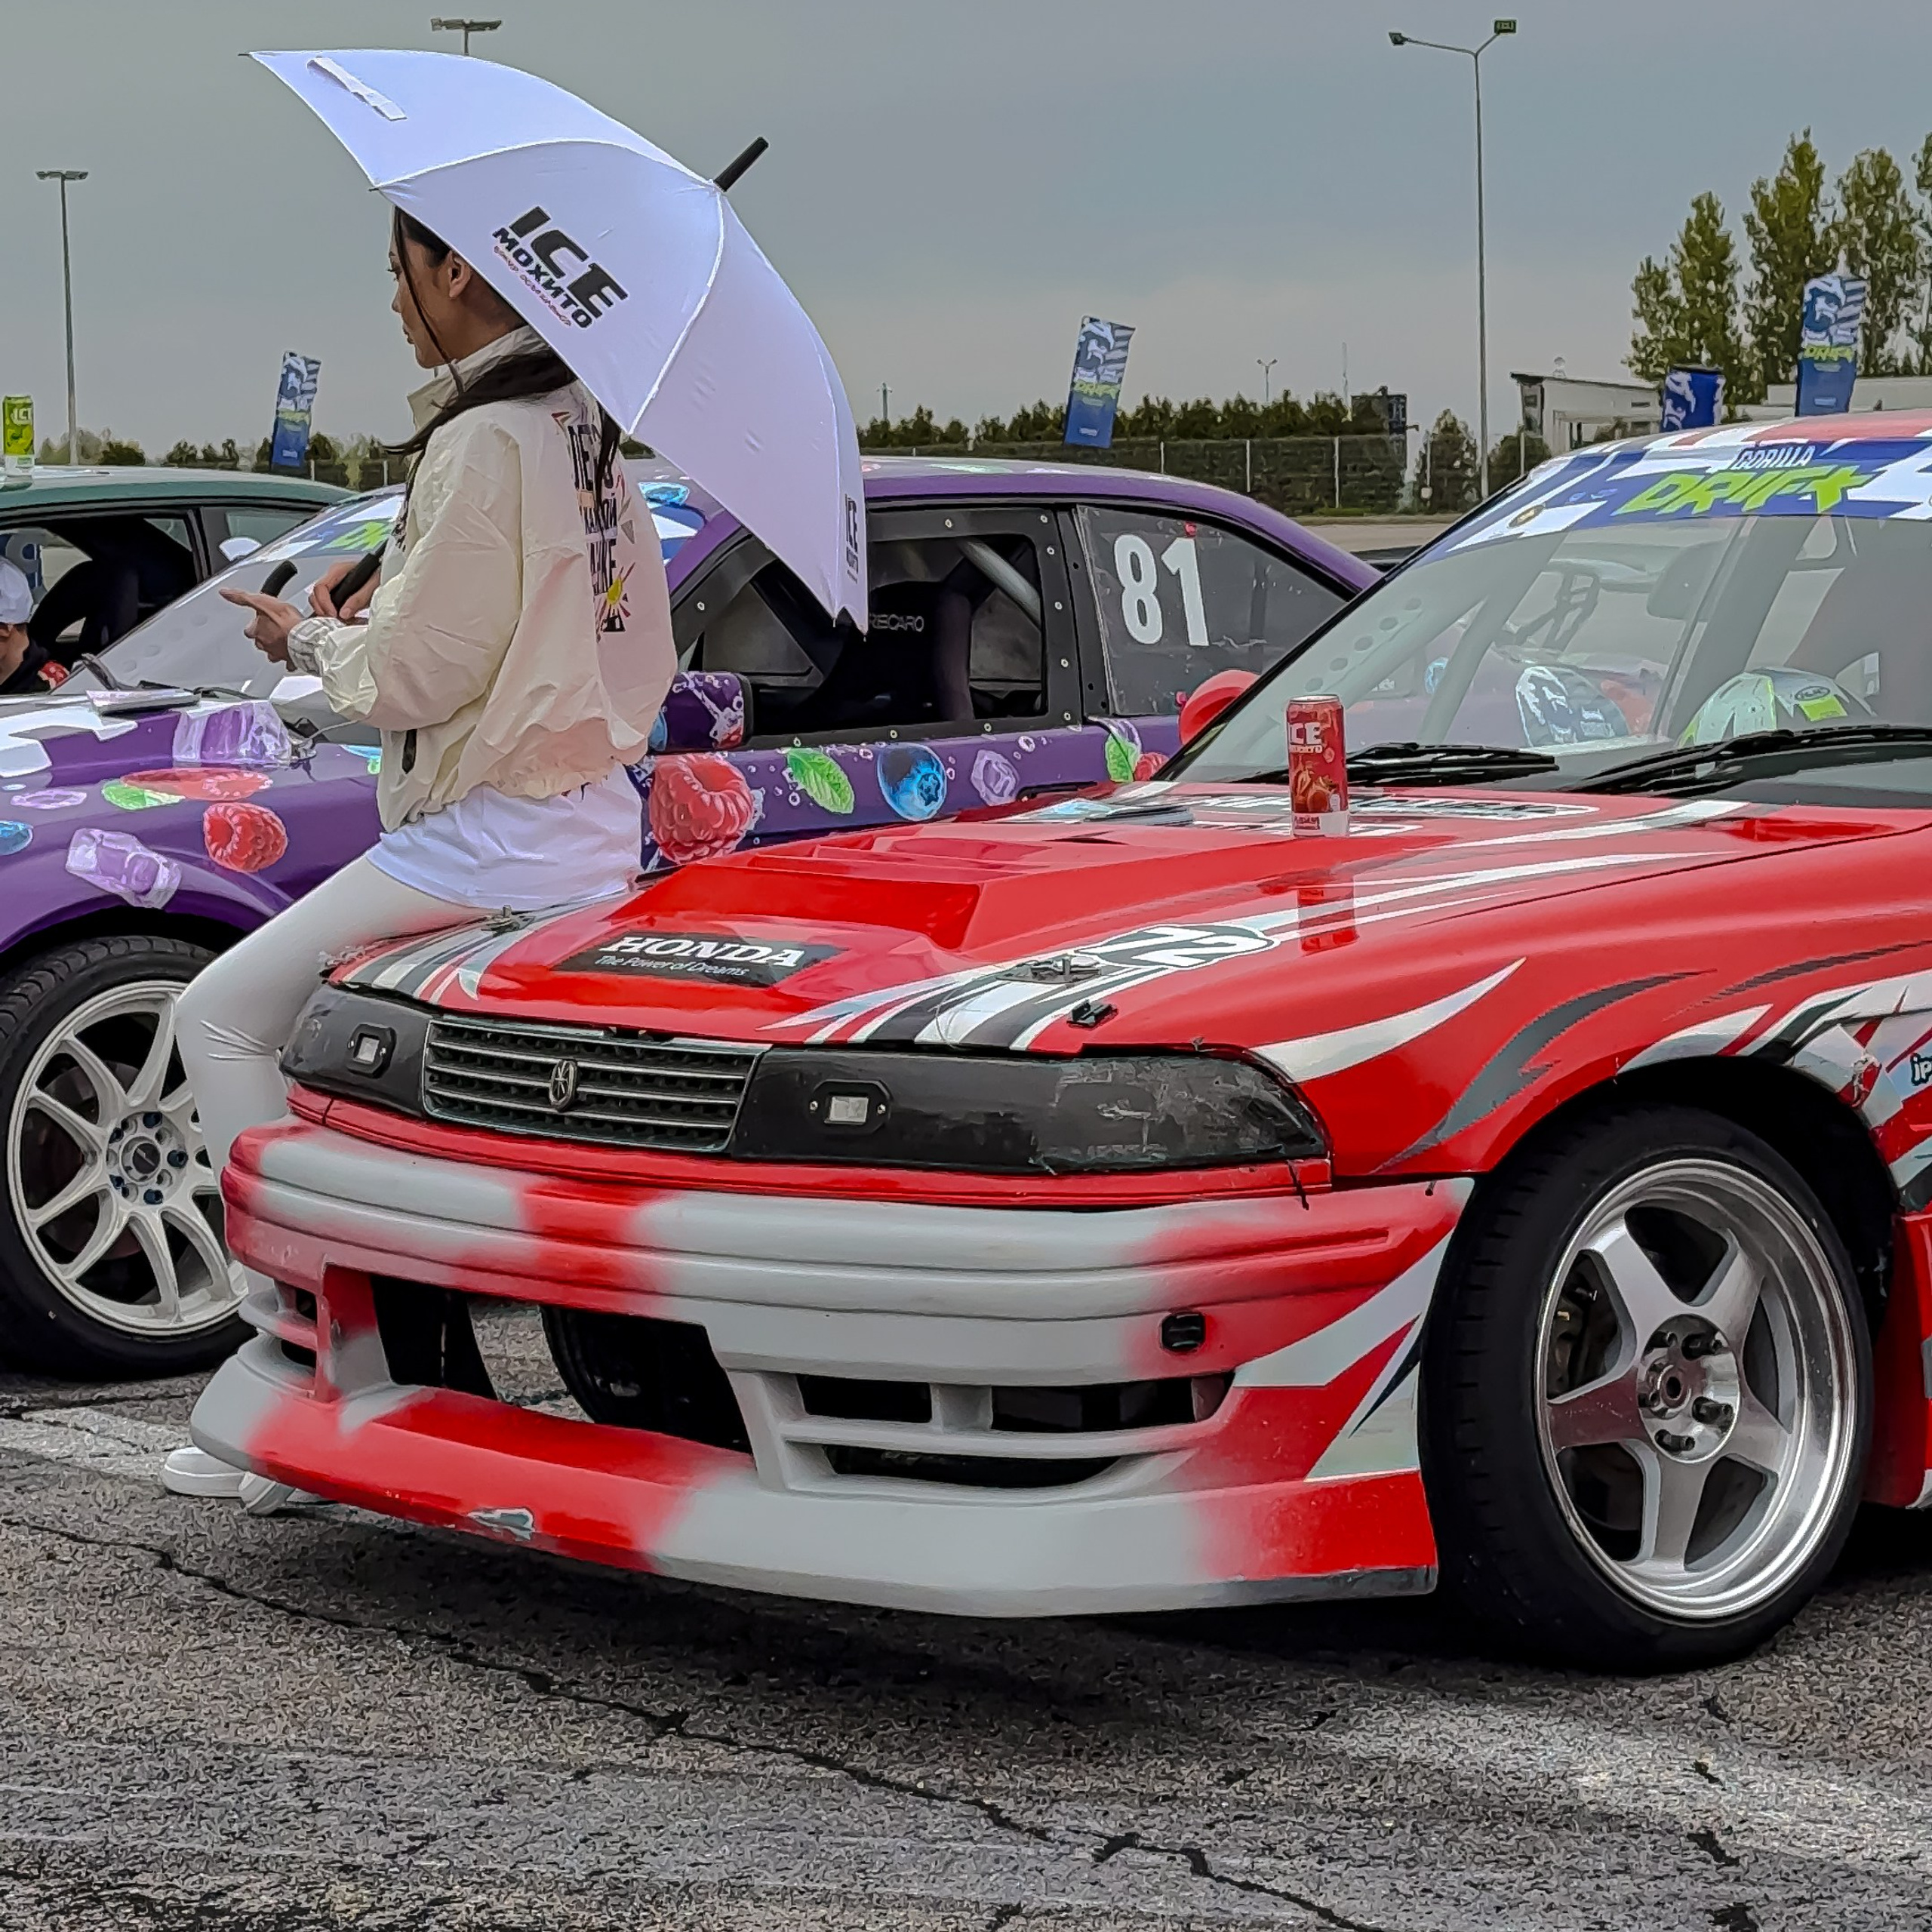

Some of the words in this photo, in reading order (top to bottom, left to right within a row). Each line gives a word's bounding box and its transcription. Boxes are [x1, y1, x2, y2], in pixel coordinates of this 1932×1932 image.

[491, 227, 593, 328] МОХИТО
[509, 205, 629, 319] ICE
[1731, 445, 1816, 470] GORILLA
[1611, 464, 1877, 516] DRIFT
[1114, 534, 1209, 647] 81
[595, 955, 624, 966] The
[622, 957, 672, 969] Power
[669, 961, 694, 971] of
[687, 961, 750, 976] Dreams
[598, 936, 805, 968] HONDA
